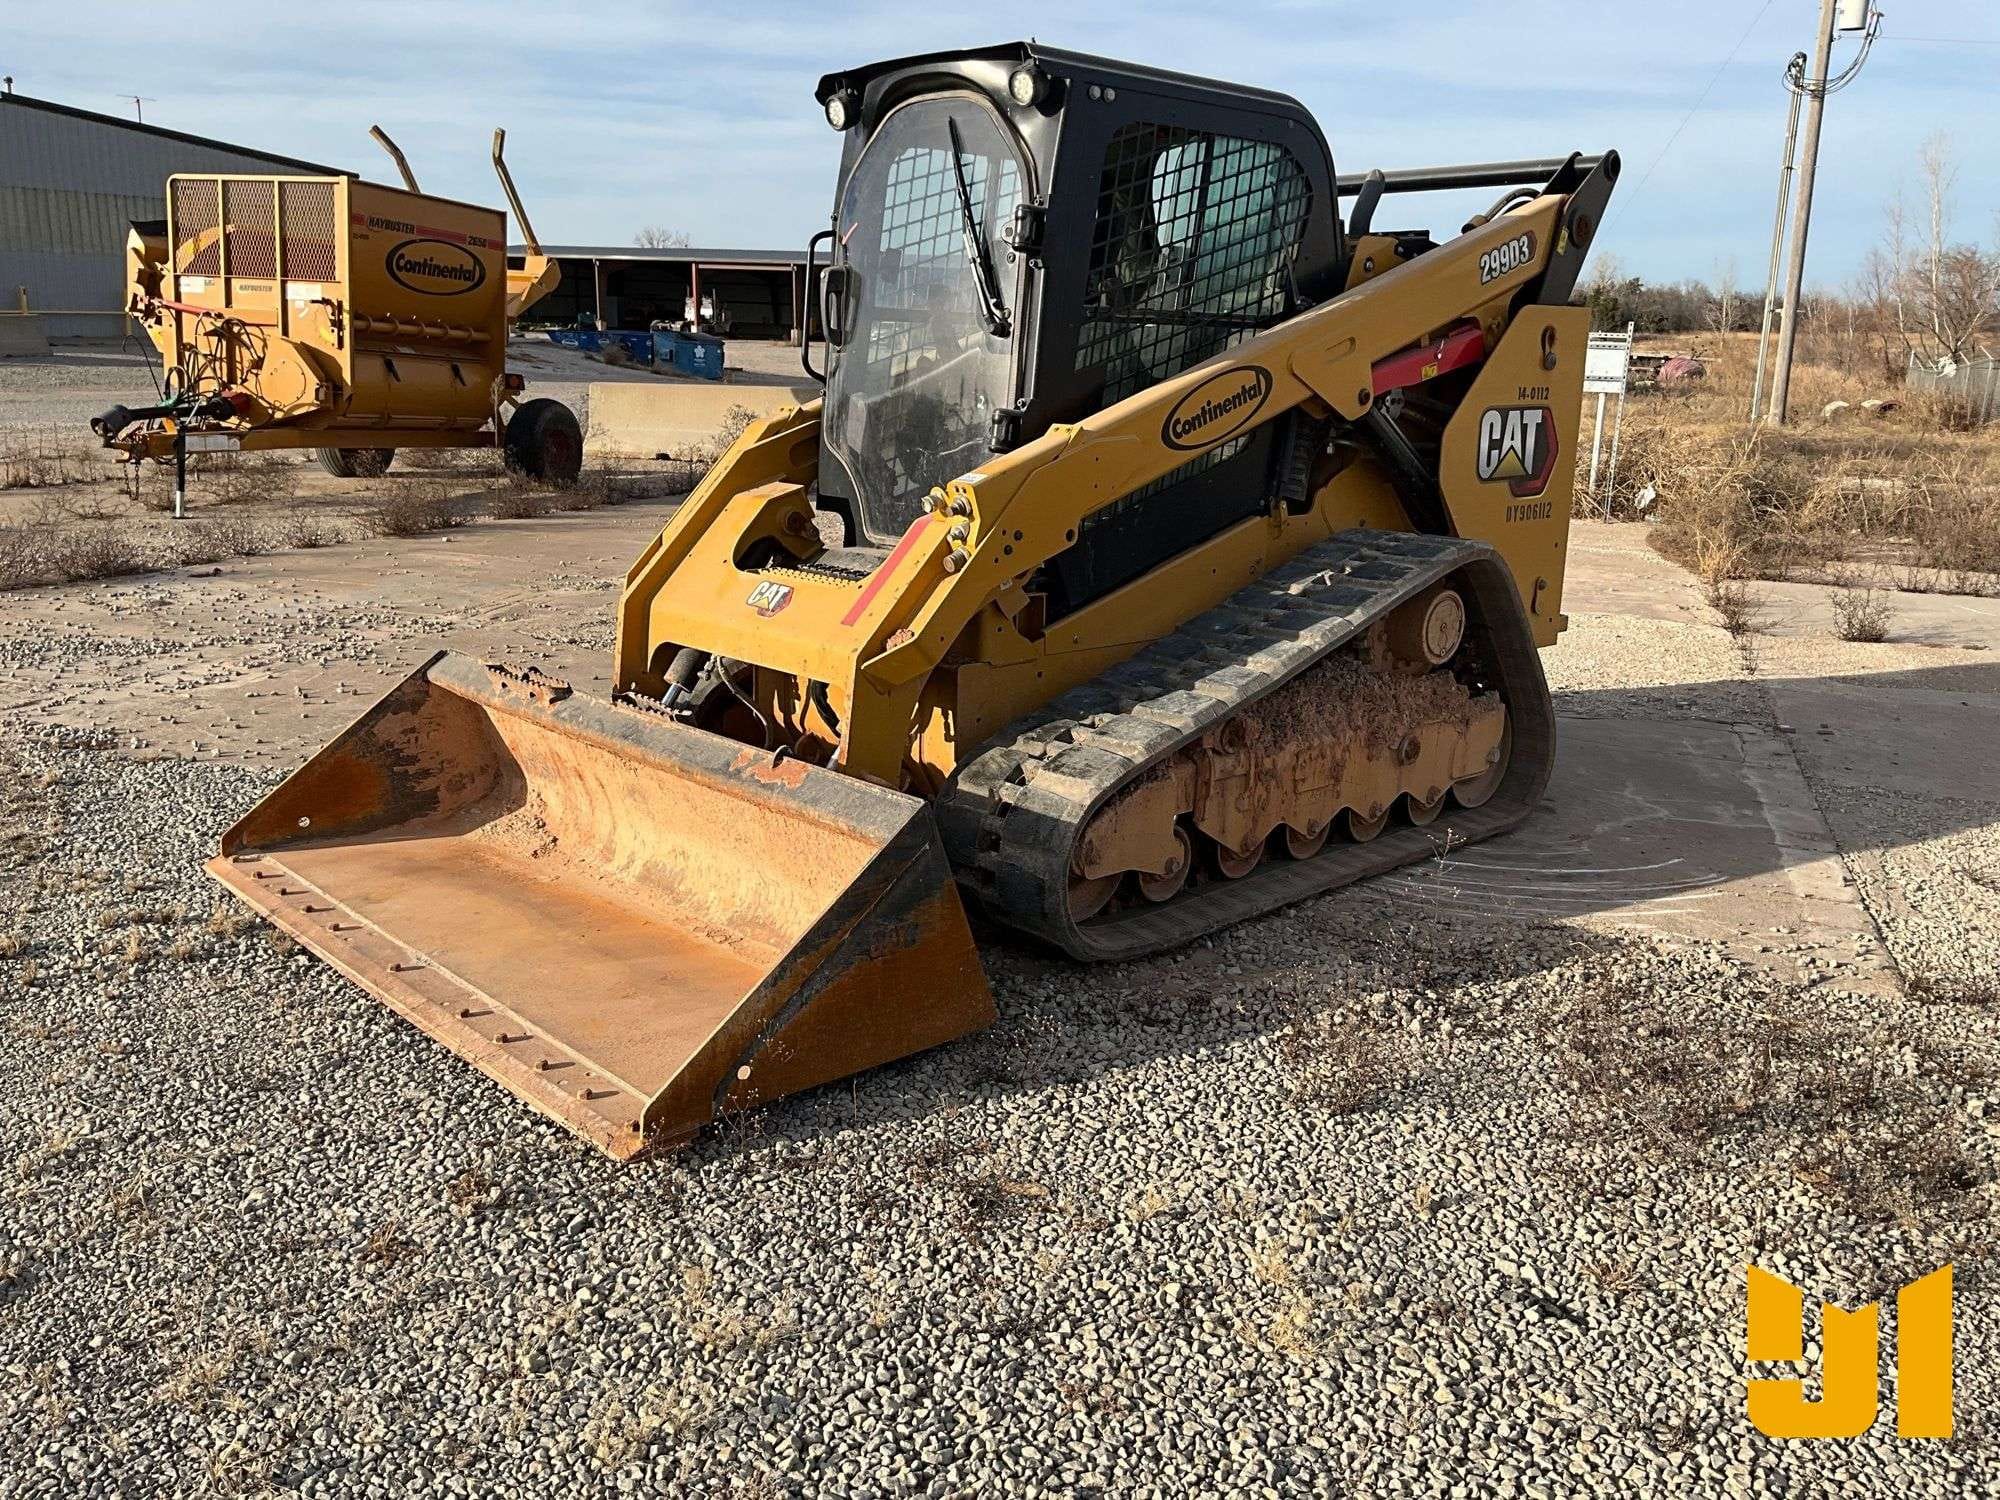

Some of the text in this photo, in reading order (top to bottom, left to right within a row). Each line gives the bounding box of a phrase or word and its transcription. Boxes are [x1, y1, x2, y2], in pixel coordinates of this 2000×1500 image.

[368, 216, 415, 234] HAYBUSTER
[395, 252, 477, 283] Continental
[1480, 235, 1529, 282] 299D3
[1172, 371, 1262, 439] Continental
[1477, 408, 1543, 480] CAT
[746, 580, 791, 611] CAT
